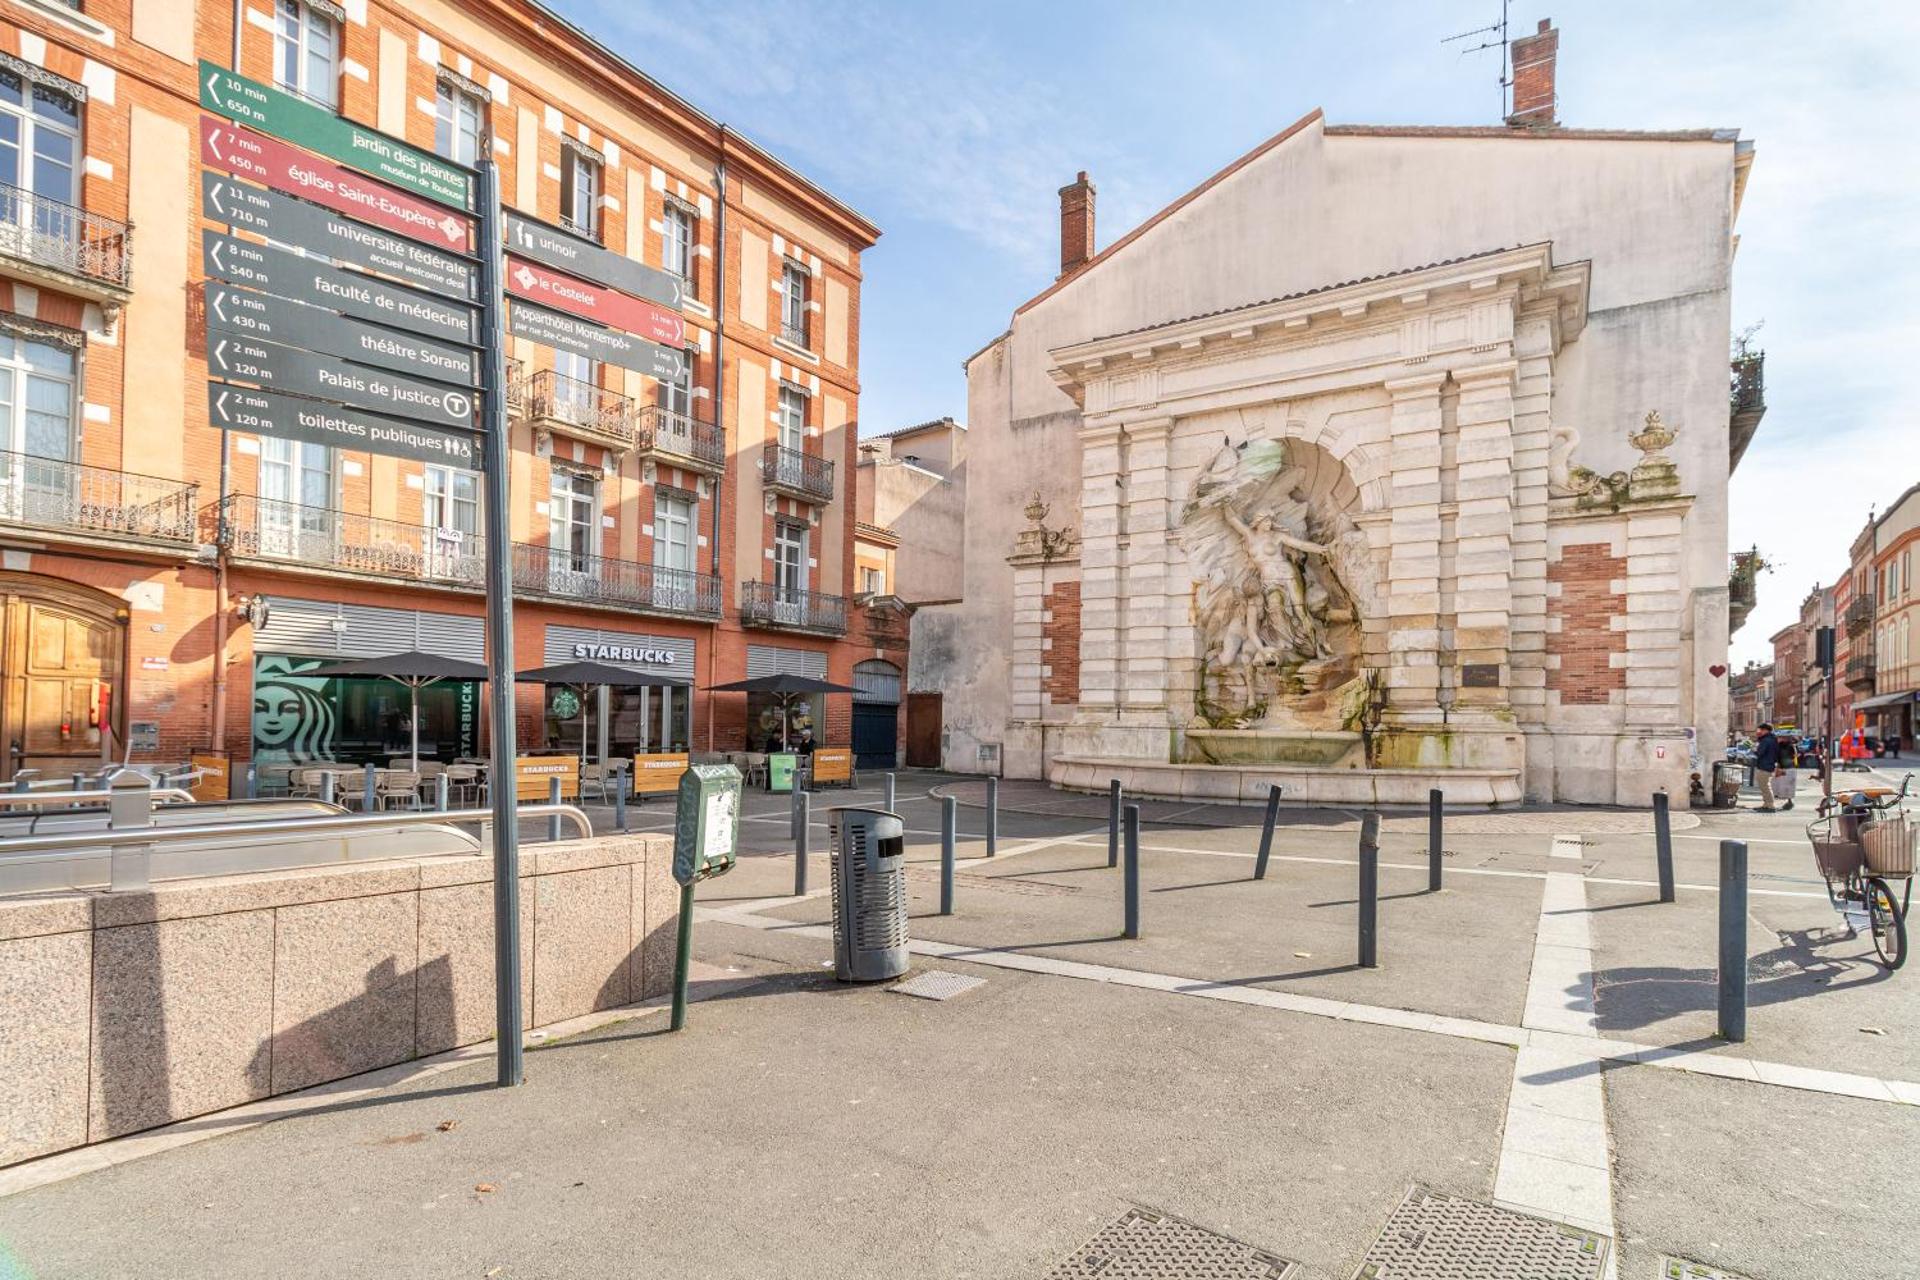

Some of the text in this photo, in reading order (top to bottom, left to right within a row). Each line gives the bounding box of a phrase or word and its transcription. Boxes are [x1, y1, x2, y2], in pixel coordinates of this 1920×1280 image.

[227, 77, 267, 103] 10 min
[227, 98, 266, 122] 650 m
[227, 134, 262, 154] 7 min
[228, 154, 267, 176] 450 m
[352, 130, 465, 188] jardin des plantes
[229, 187, 270, 209] 11 min
[288, 165, 436, 229] église Saint-Exupère
[418, 177, 430, 188] de
[430, 180, 465, 202] Toulouse
[230, 207, 268, 228] 710 m
[229, 244, 263, 262] 8 min
[327, 221, 467, 277] université fédérale
[539, 238, 577, 259] urinoir
[230, 264, 268, 284] 540 m
[369, 254, 403, 270] accueil
[405, 265, 445, 283] welcome
[539, 276, 595, 306] le Castelet
[231, 294, 265, 312] 6 min
[314, 277, 468, 330] faculté de médecine
[232, 314, 271, 332] 430 m
[514, 305, 574, 333] Apparthôtel
[514, 322, 528, 333] par
[529, 327, 542, 336] rue
[233, 342, 267, 359] 2 min
[360, 335, 470, 373] théâtre Sorano
[234, 362, 273, 380] 120 m
[319, 369, 366, 392] Palais
[370, 381, 389, 396] de
[392, 385, 441, 407] justice
[234, 394, 268, 409] 2 min
[235, 413, 273, 429] 120 m
[298, 411, 443, 451] toilettes publiques
[575, 643, 675, 664] STARBUCKS
